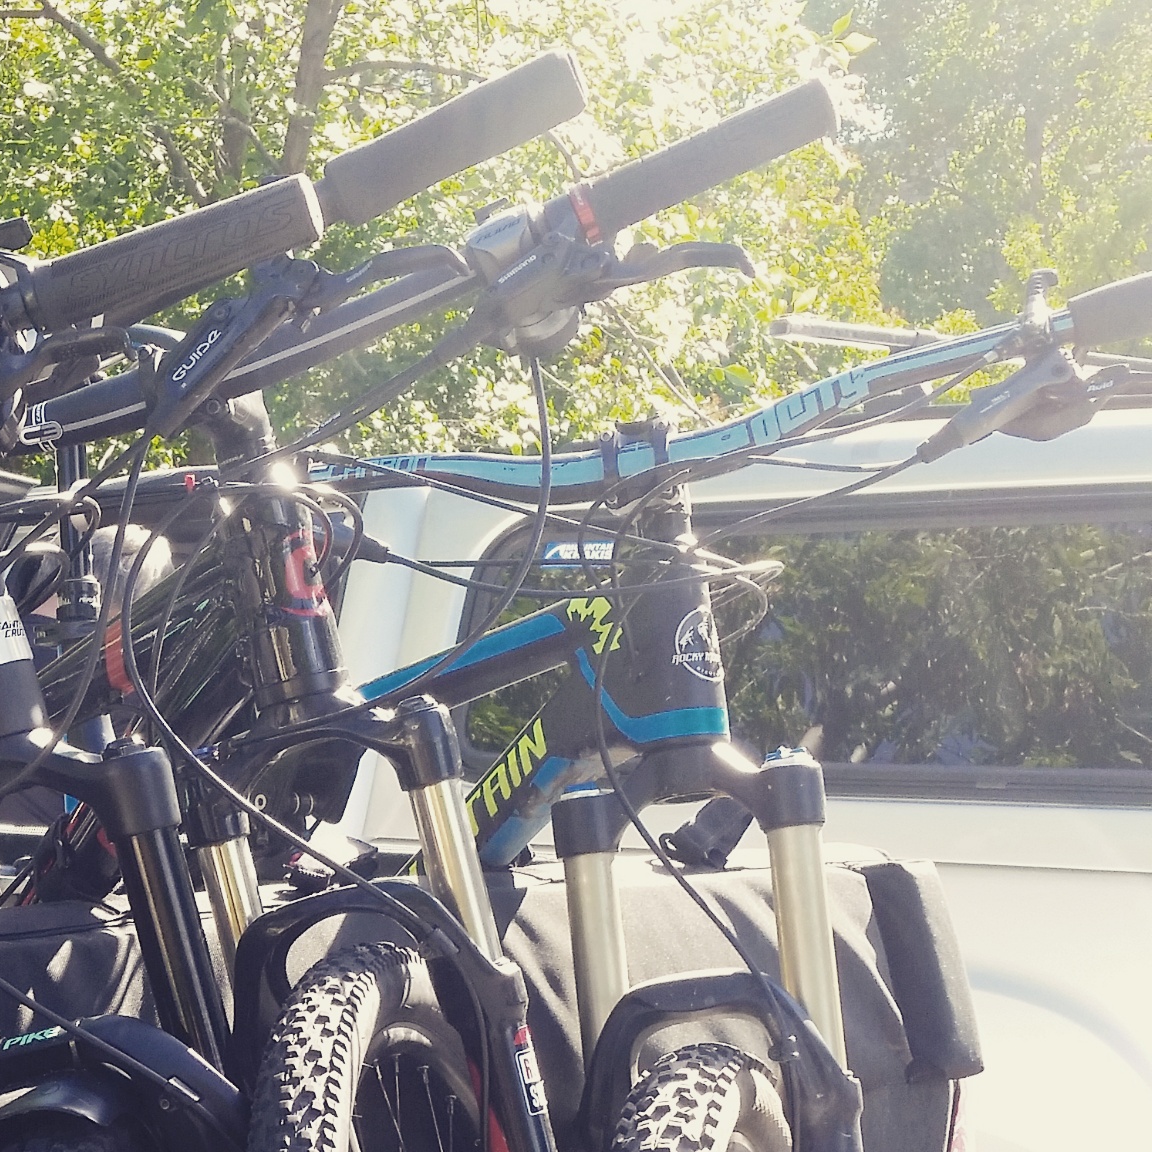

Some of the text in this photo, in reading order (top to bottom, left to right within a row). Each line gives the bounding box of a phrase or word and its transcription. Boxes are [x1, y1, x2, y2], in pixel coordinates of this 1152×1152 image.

[498, 253, 537, 285] SHIMANO
[172, 329, 222, 382] GUIDE
[671, 651, 705, 666] ROCKY
[2, 1026, 68, 1050] PIKE
